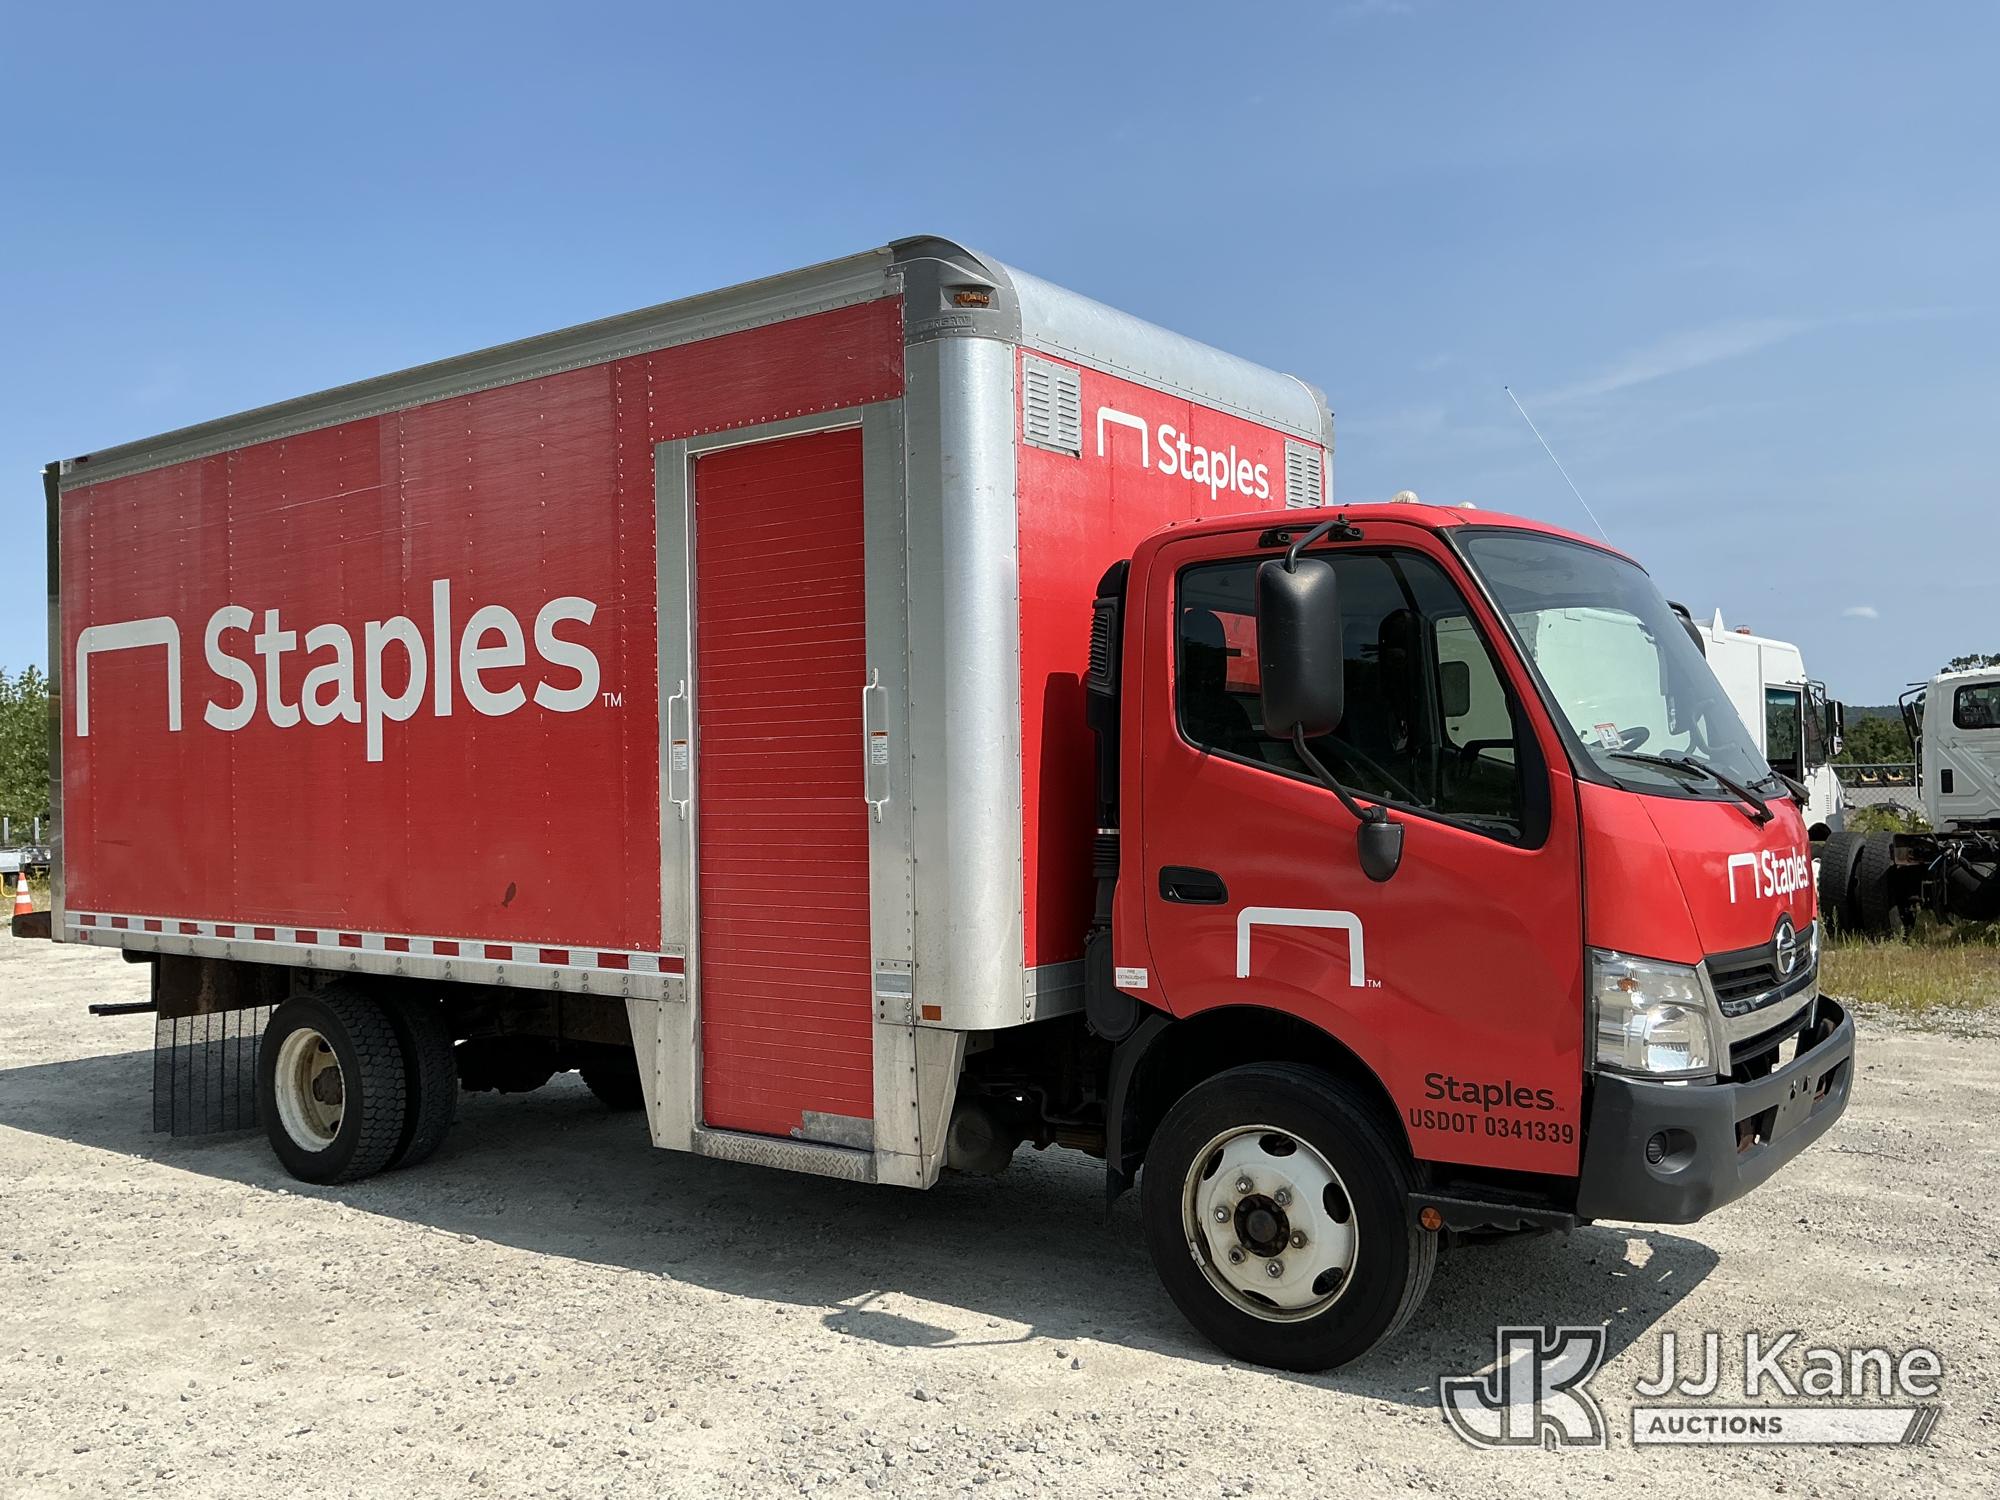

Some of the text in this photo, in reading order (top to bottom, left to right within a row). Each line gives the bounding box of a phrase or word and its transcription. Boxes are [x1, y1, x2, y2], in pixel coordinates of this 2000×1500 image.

[1157, 424, 1270, 501] Staples
[204, 578, 621, 762] Staples TM
[1761, 846, 1809, 905] Staples
[1366, 979, 1382, 988] TM
[1424, 1072, 1556, 1112] Staples
[1409, 1108, 1574, 1144] USDOT 0341339
